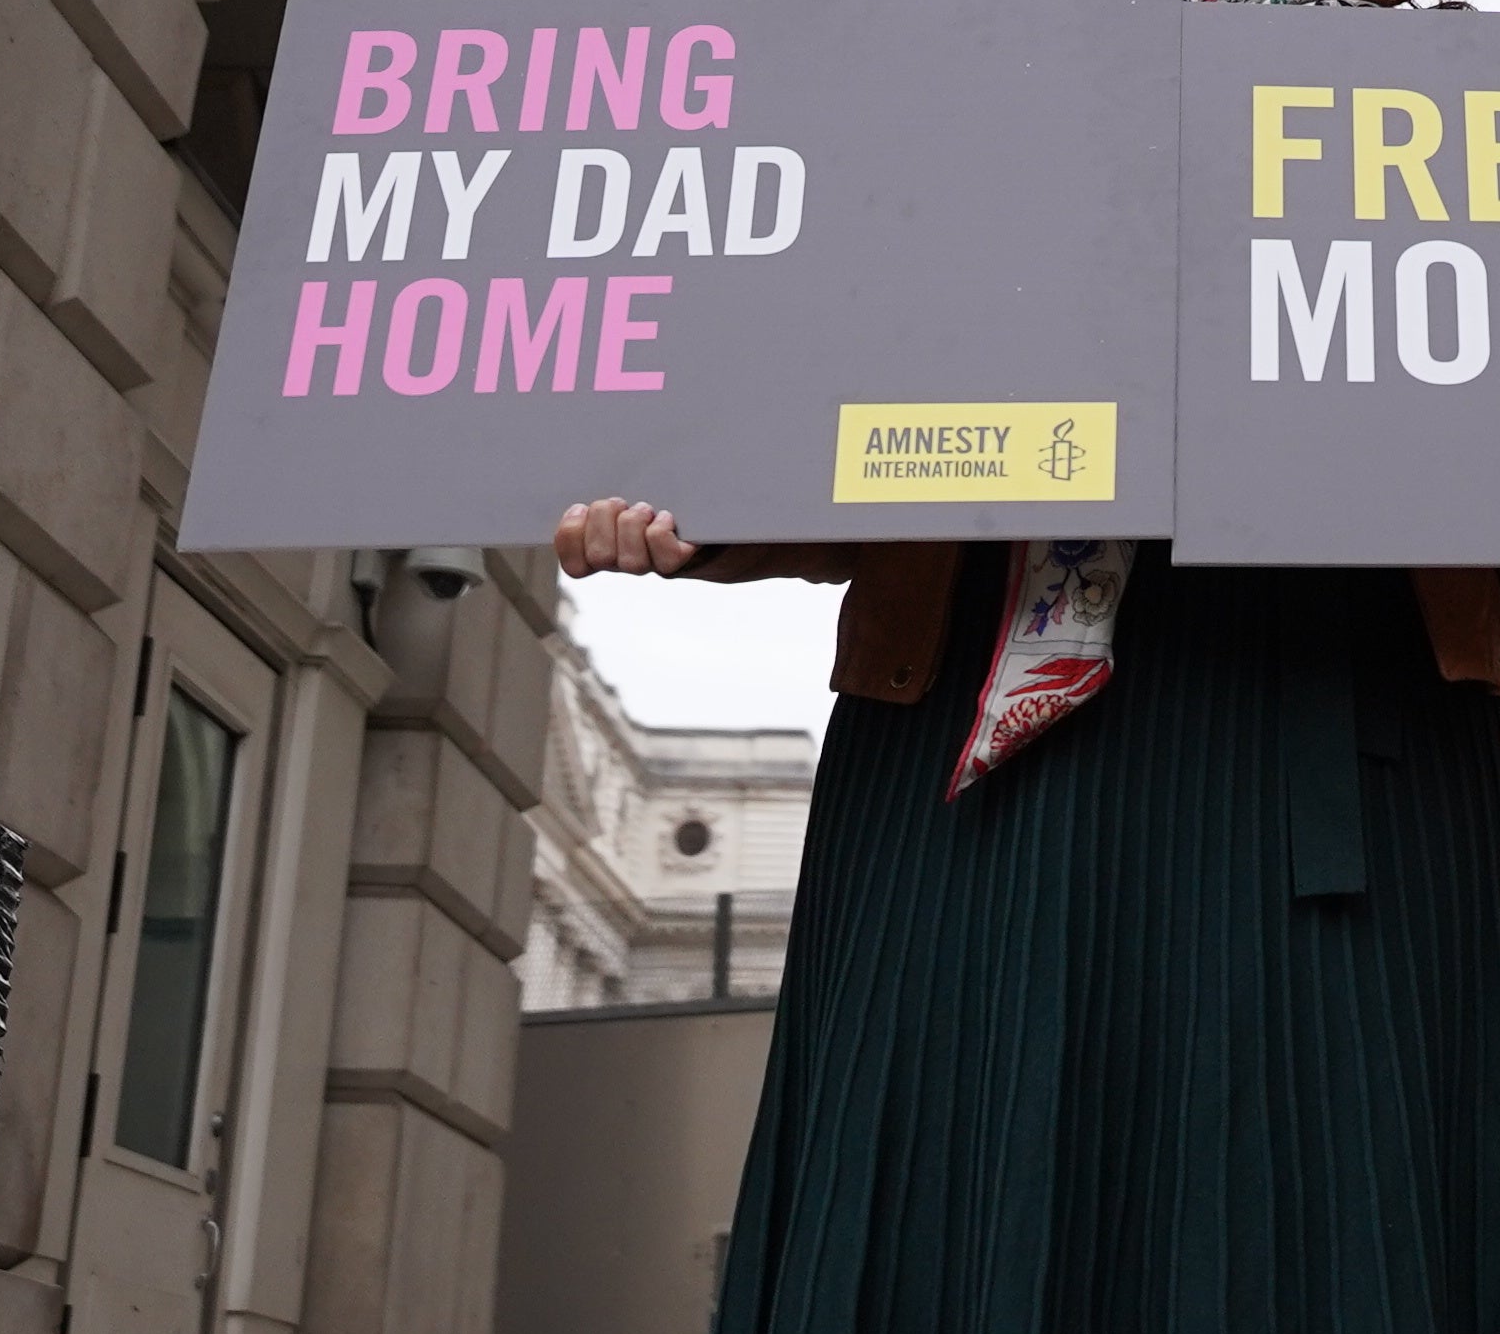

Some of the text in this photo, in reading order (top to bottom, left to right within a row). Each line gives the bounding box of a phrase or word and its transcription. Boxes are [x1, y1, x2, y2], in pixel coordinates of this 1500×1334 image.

[332, 24, 736, 135] BRING
[305, 145, 806, 263] MY DAD
[282, 275, 673, 398] HOME
[863, 460, 1009, 479] INTERNATIONAL
[864, 426, 1012, 455] AMNESTY
